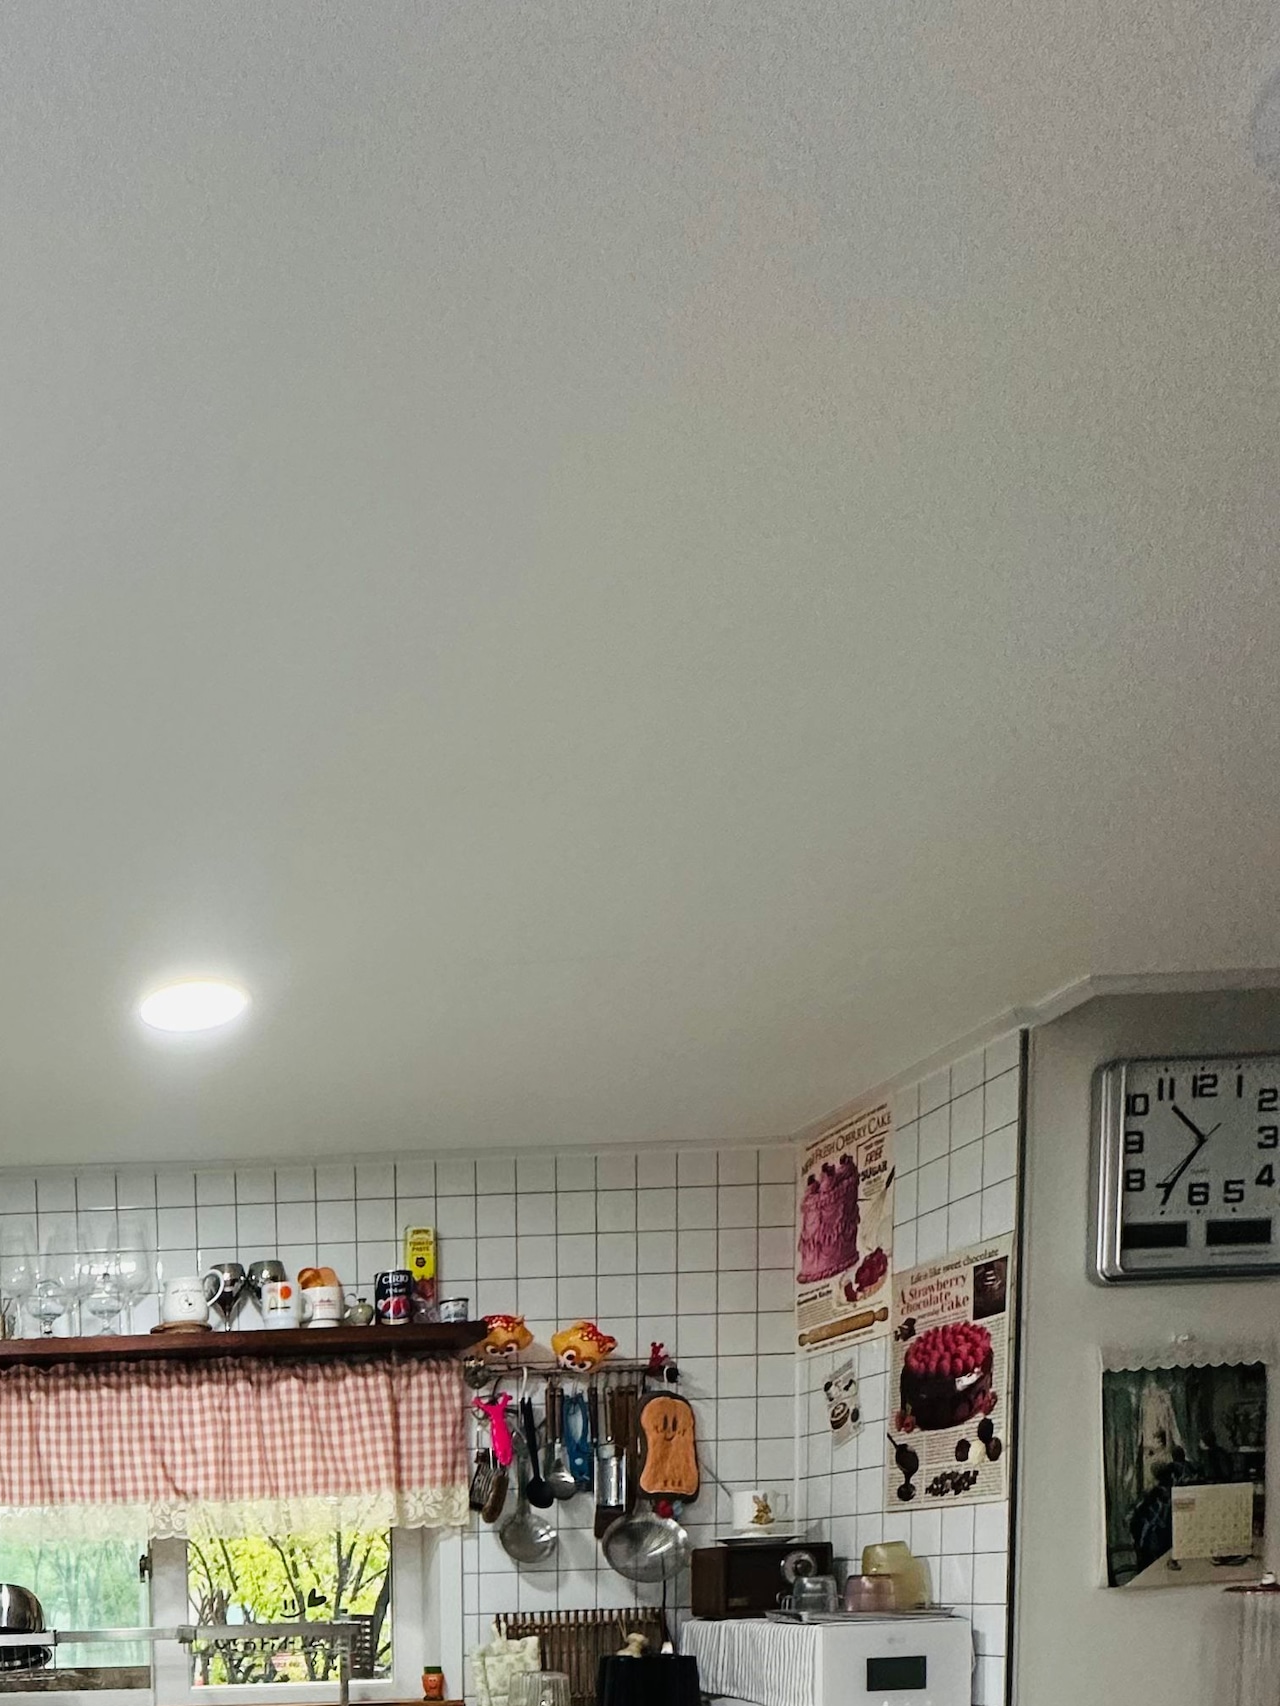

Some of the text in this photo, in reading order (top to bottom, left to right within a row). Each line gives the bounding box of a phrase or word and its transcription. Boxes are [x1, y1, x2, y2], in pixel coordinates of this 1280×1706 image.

[1158, 1074, 1243, 1101] 11 12 1
[1125, 1093, 1149, 1116] 10
[1258, 1088, 1278, 1112] 2
[1125, 1131, 1144, 1154] 9
[1257, 1126, 1278, 1149] 3
[1125, 1169, 1145, 1192] 8
[1255, 1164, 1275, 1187] 4
[1155, 1182, 1173, 1206] 7
[1188, 1182, 1209, 1206] 6
[1223, 1179, 1245, 1203] 5
